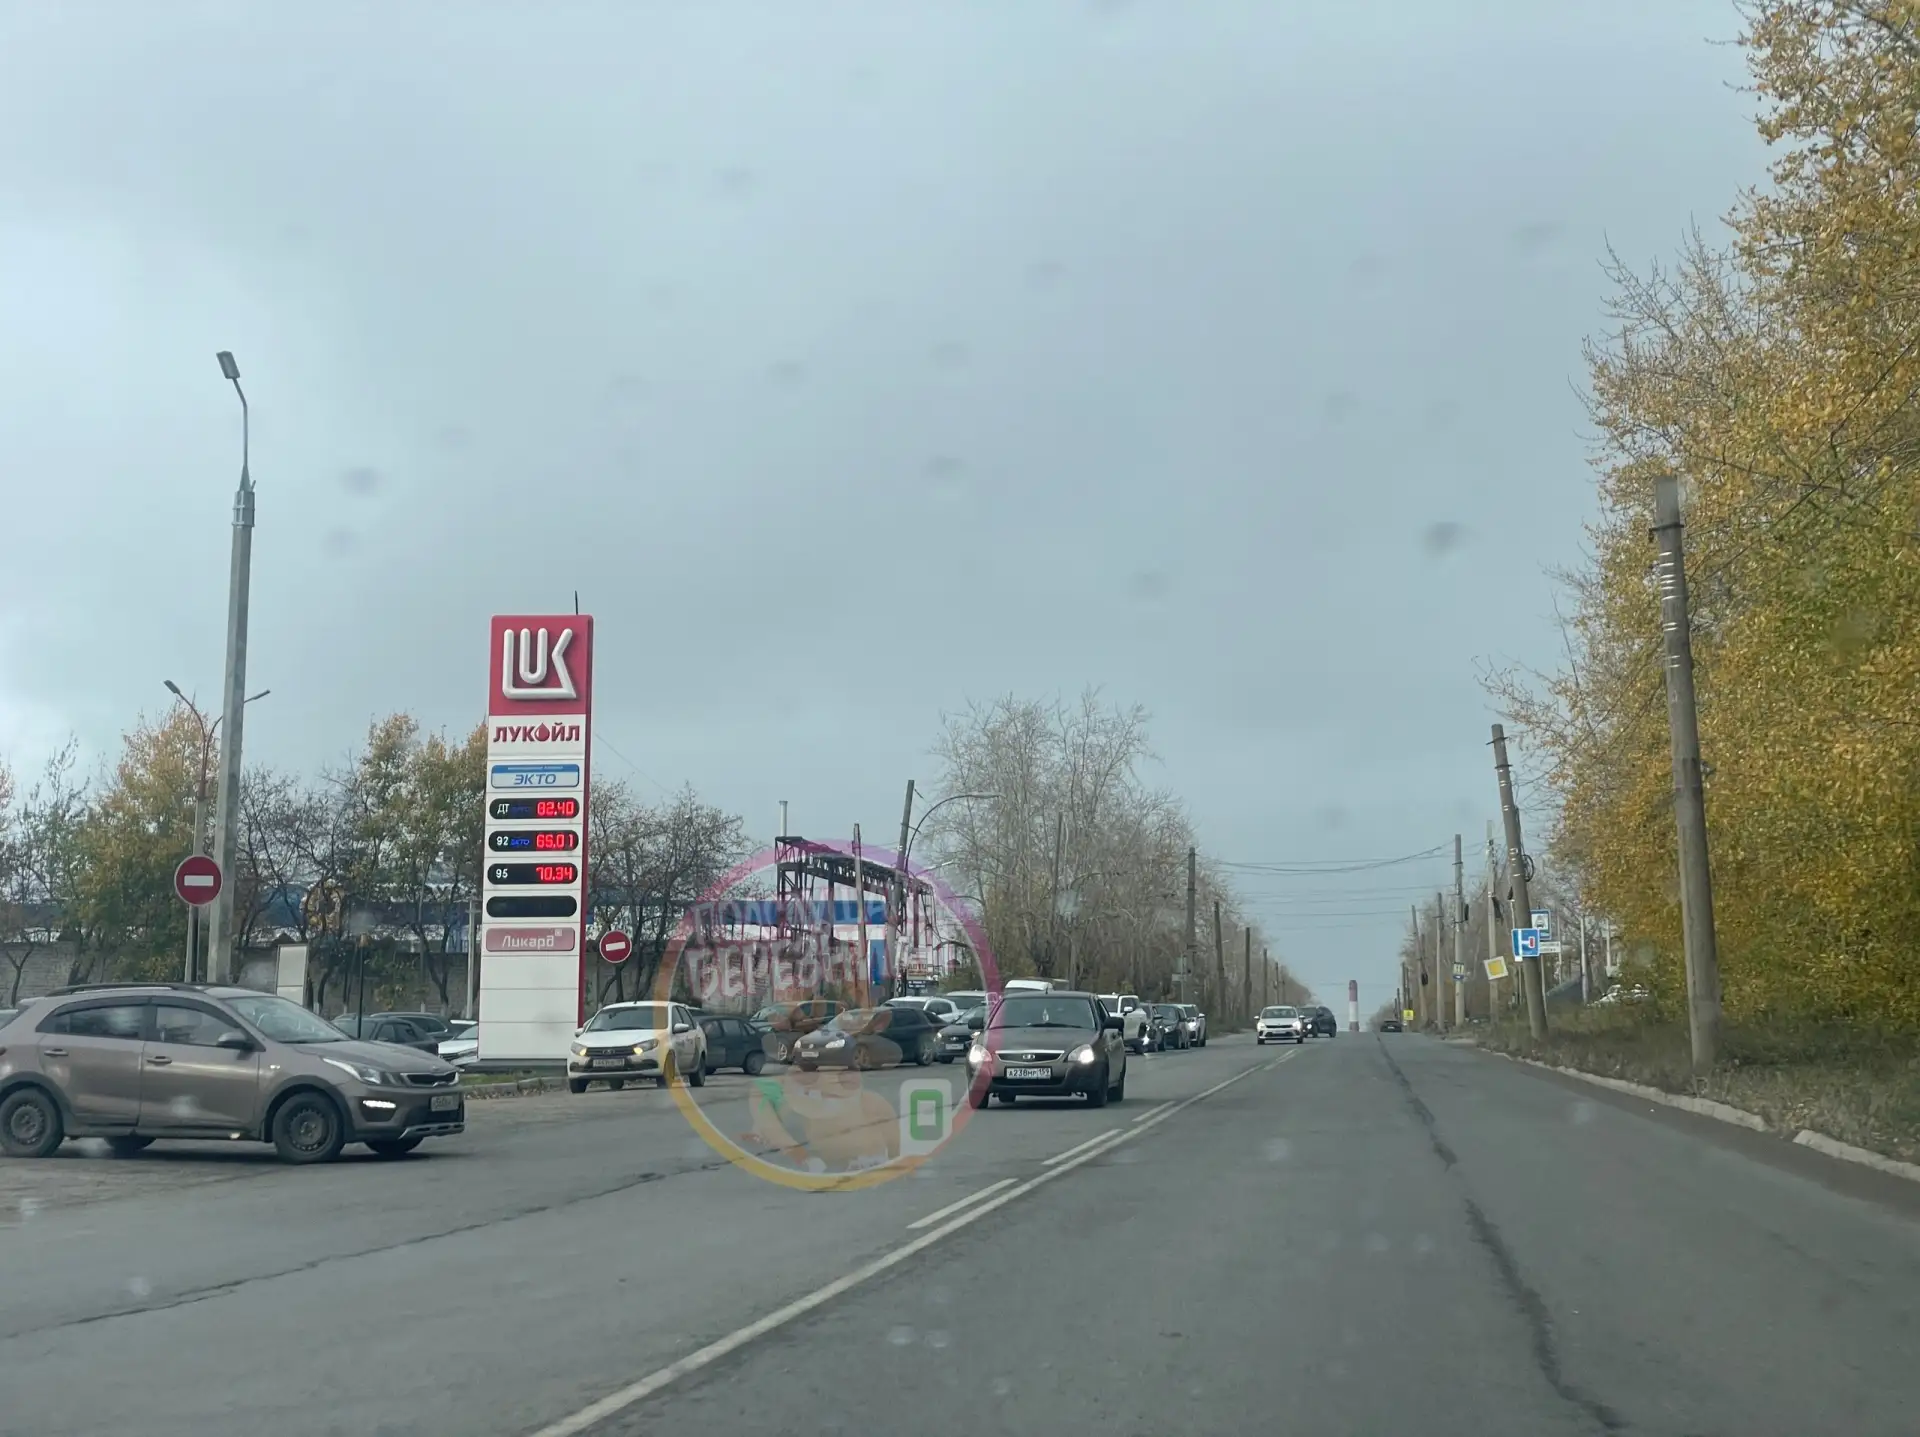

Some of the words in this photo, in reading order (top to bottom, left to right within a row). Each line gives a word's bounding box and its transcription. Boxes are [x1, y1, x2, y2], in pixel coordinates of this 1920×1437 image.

[493, 722, 580, 743] ЛУКОЙЛ
[514, 773, 556, 786] ЭКТО
[496, 803, 510, 815] ДТ
[496, 835, 509, 846] 92
[495, 868, 509, 879] 95
[535, 866, 573, 881] 70.34
